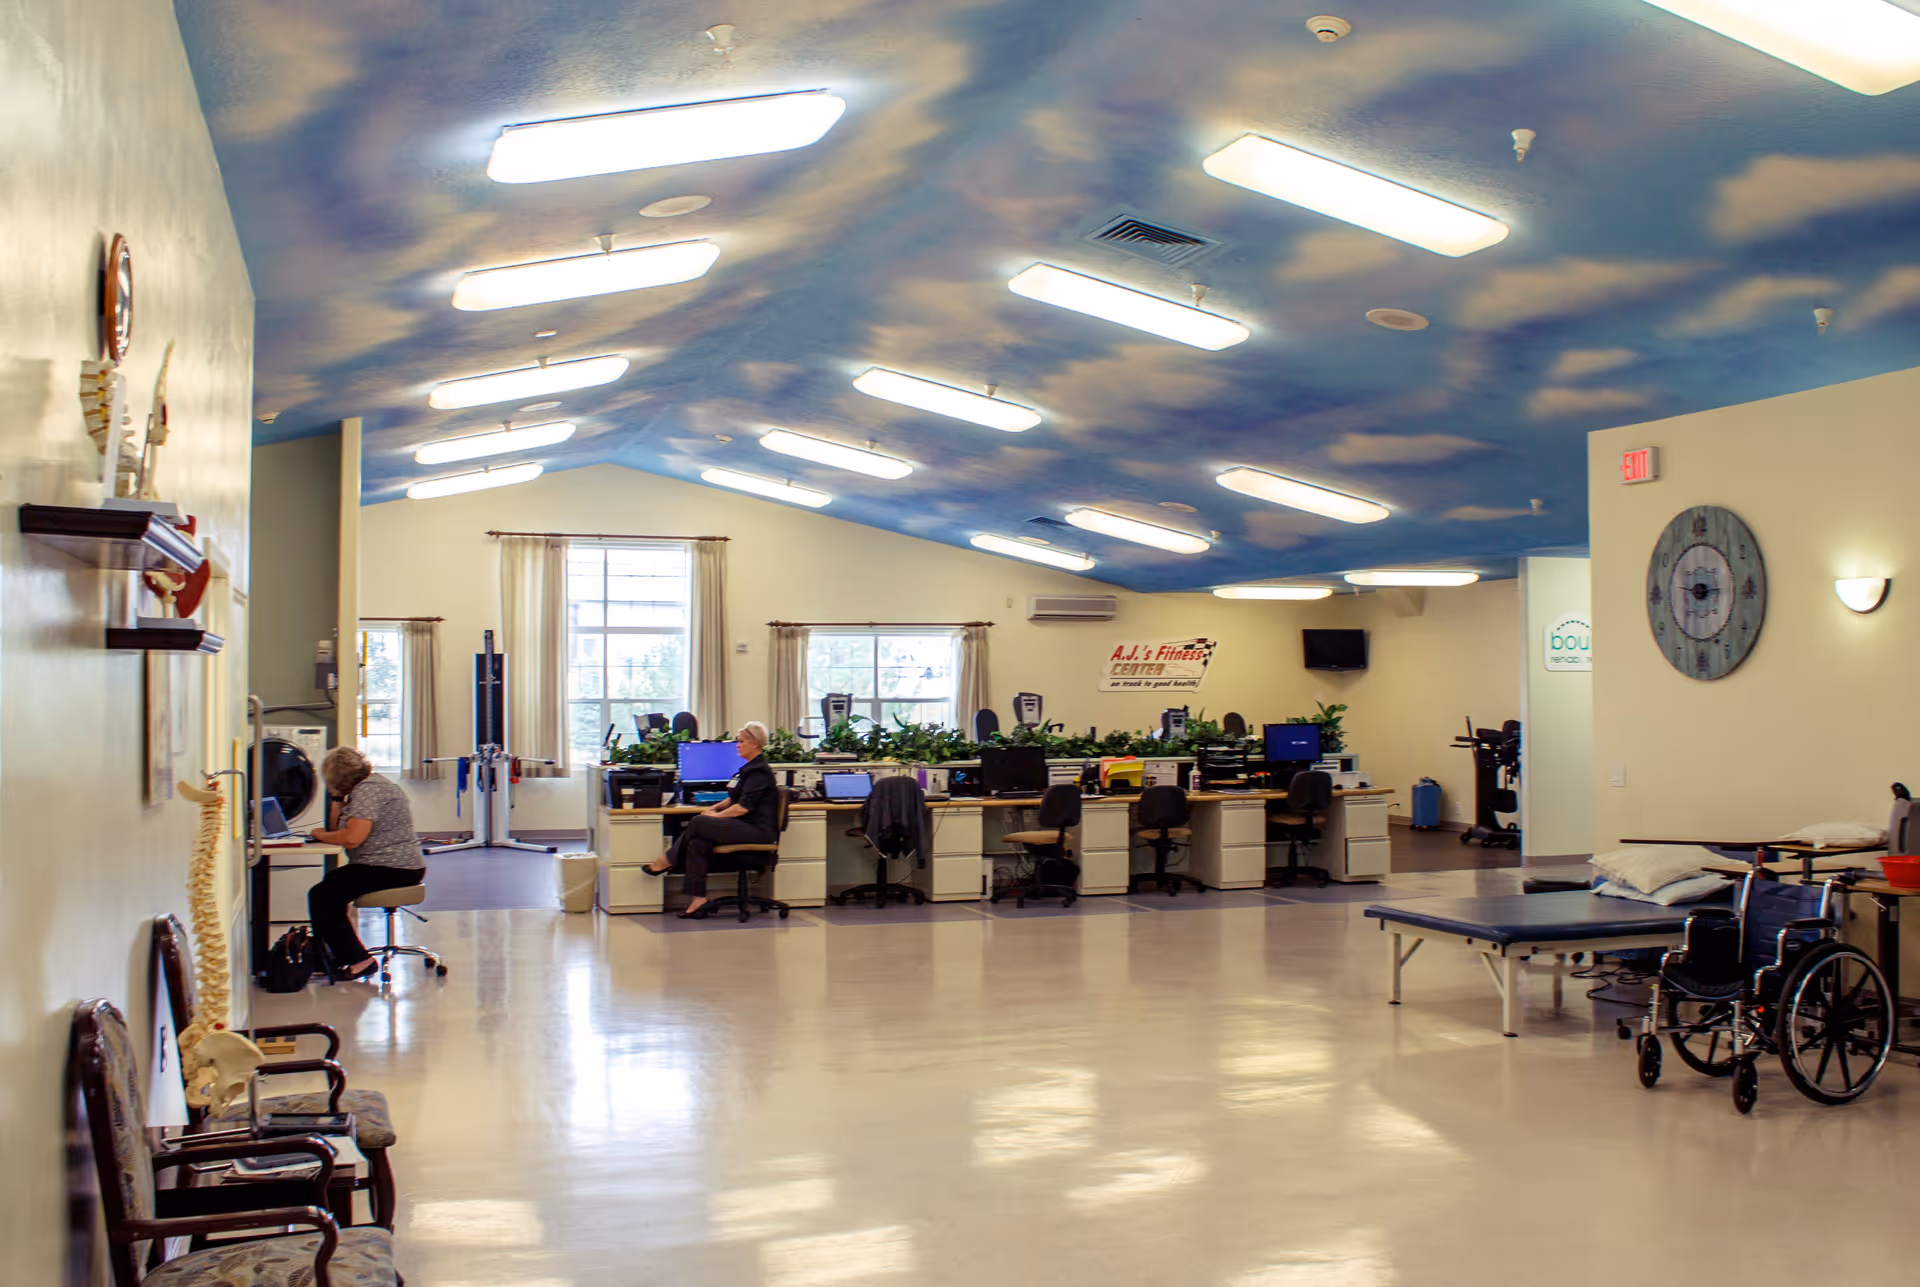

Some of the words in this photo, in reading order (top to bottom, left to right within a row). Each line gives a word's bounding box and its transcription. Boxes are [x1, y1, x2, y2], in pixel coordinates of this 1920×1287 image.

[1624, 450, 1648, 480] EXIT
[1551, 632, 1589, 650] bou
[1155, 646, 1204, 661] Fitness
[1111, 663, 1165, 676] CENTER
[1153, 680, 1173, 689] good
